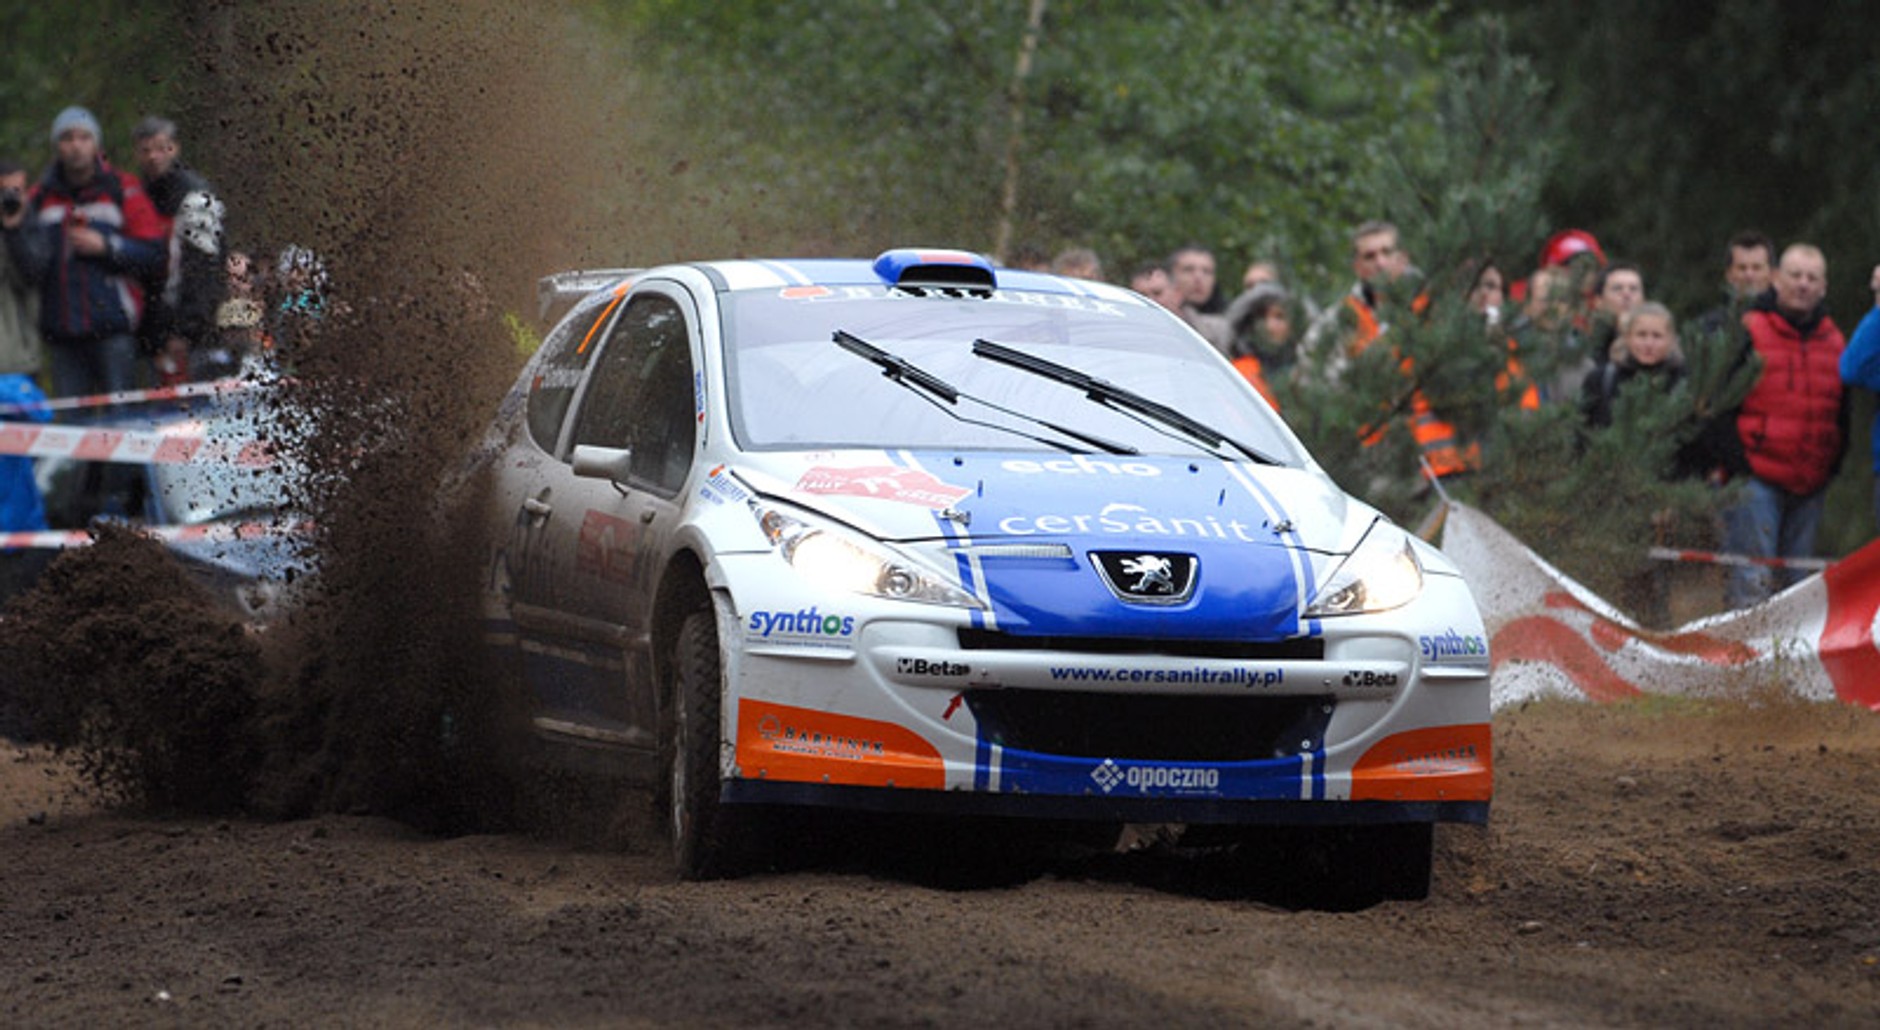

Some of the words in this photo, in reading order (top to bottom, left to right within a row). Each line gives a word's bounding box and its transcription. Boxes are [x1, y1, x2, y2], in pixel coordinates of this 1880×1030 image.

[1001, 453, 1162, 477] echo
[998, 505, 1254, 542] cersanit
[749, 606, 854, 637] synthos
[1419, 628, 1486, 661] synthos
[914, 658, 961, 676] Beta
[1050, 665, 1284, 688] www.cersanitrally.pl
[1363, 670, 1398, 687] Beta
[785, 726, 884, 756] BARLINEK
[1127, 766, 1219, 792] opoczno
